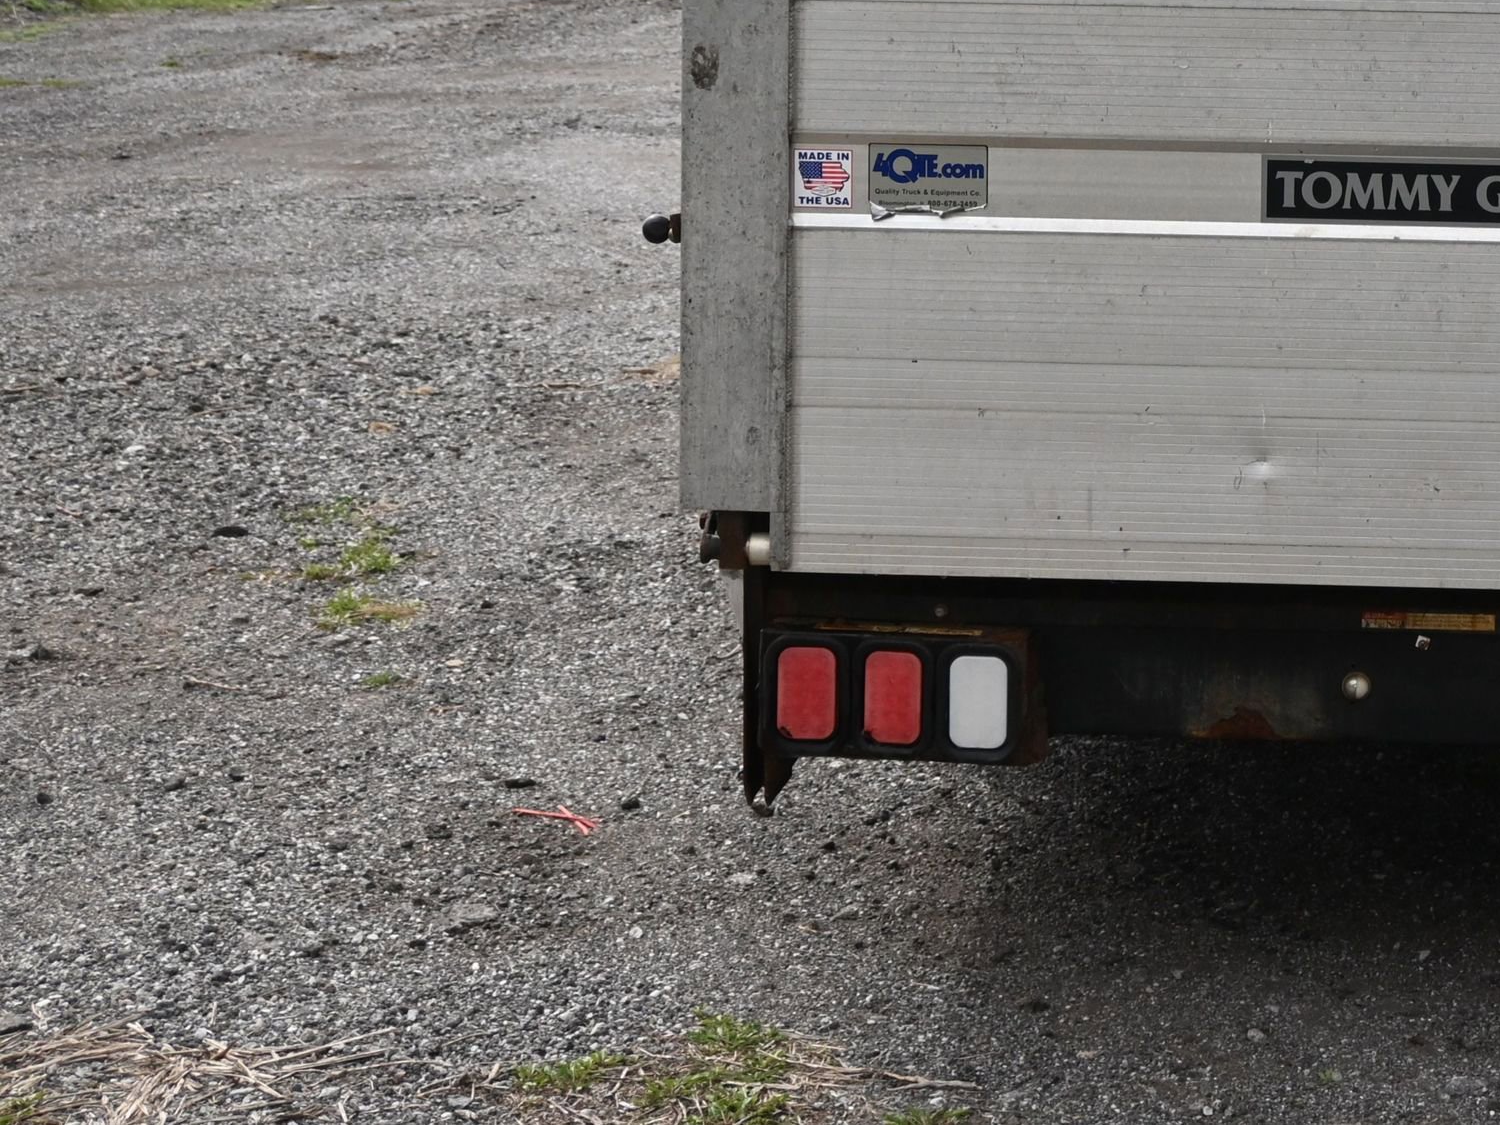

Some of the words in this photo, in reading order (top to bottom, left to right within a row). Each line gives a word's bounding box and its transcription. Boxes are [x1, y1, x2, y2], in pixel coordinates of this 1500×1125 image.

[798, 151, 833, 161] MADE
[837, 152, 850, 161] IN
[874, 188, 900, 196] Quality
[930, 189, 968, 197] Equipment
[1275, 170, 1461, 212] TOMMY
[798, 196, 822, 205] THE
[825, 196, 850, 206] USA
